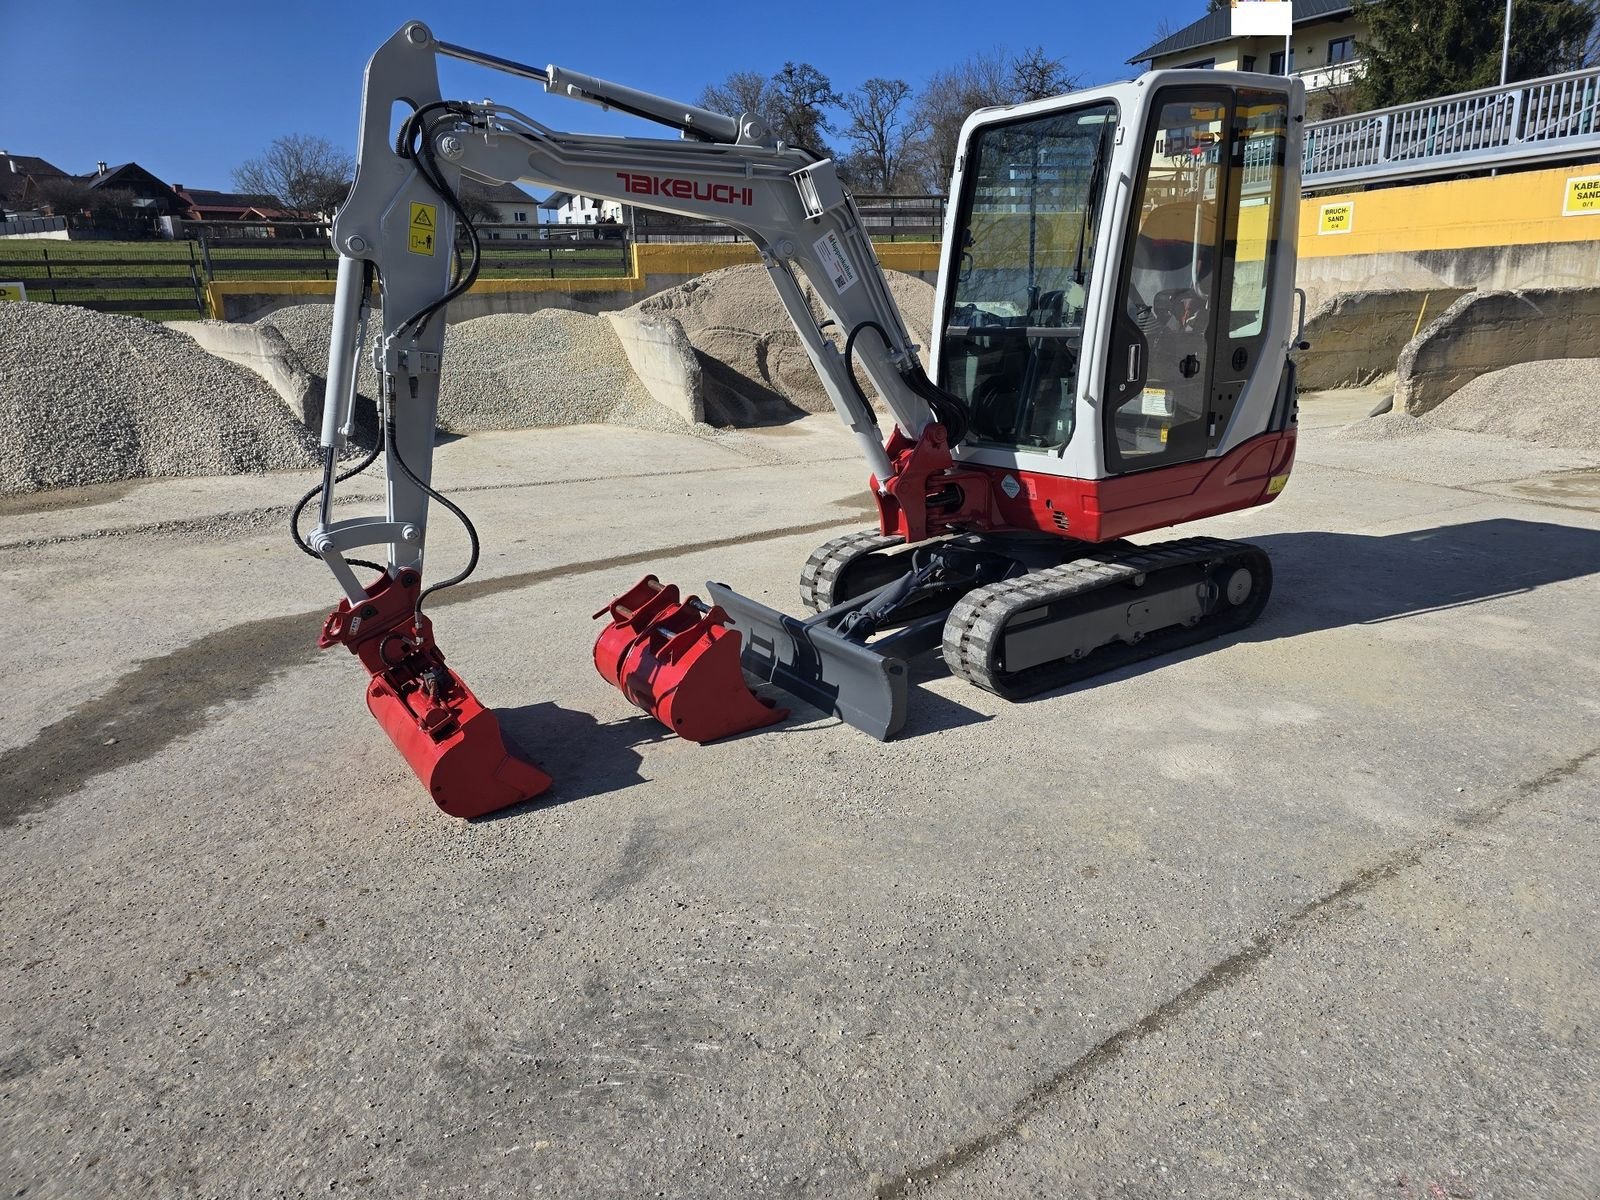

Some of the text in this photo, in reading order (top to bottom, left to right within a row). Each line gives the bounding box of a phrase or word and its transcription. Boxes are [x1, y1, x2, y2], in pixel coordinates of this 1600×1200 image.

[616, 172, 753, 206] TAKEUCHI
[1574, 181, 1600, 190] KABE
[1325, 207, 1348, 215] BRUCH-
